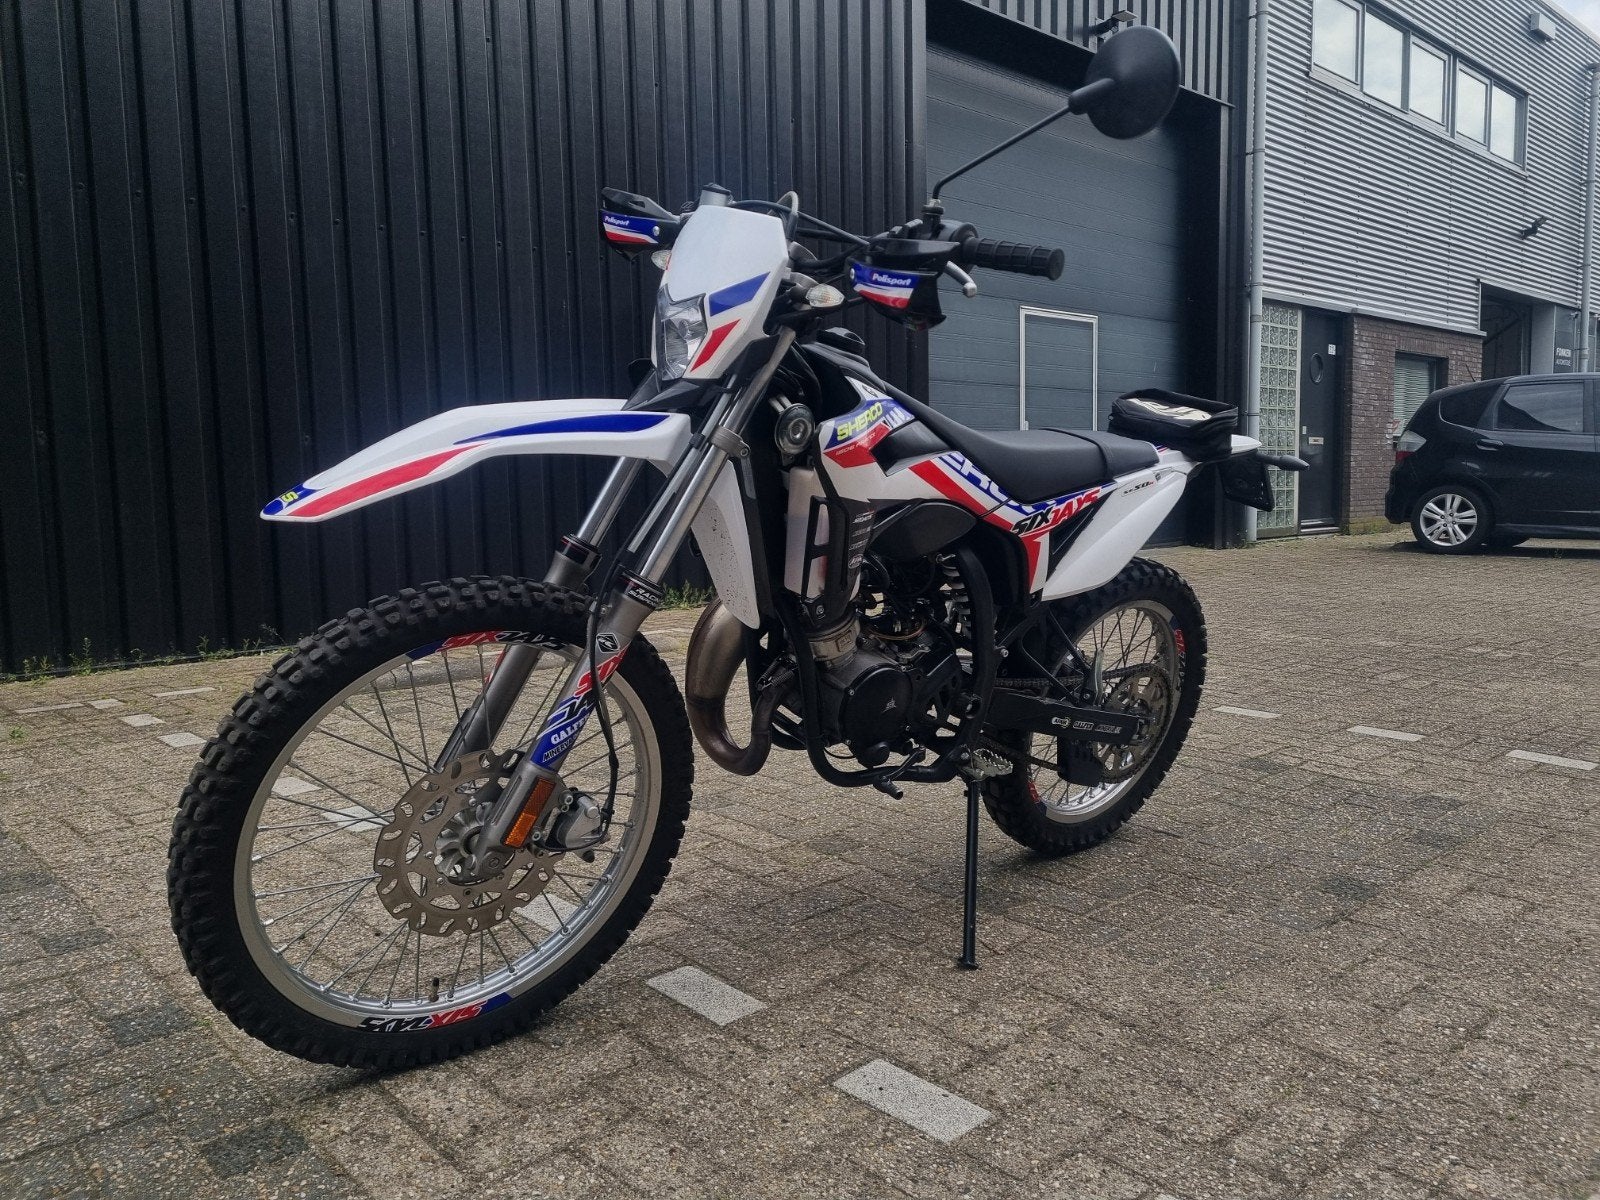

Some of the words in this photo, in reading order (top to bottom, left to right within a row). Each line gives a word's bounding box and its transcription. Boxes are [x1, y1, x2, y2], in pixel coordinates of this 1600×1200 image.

[604, 215, 630, 226] Polisport
[872, 273, 912, 286] Polisport
[836, 401, 883, 441] SHERCO
